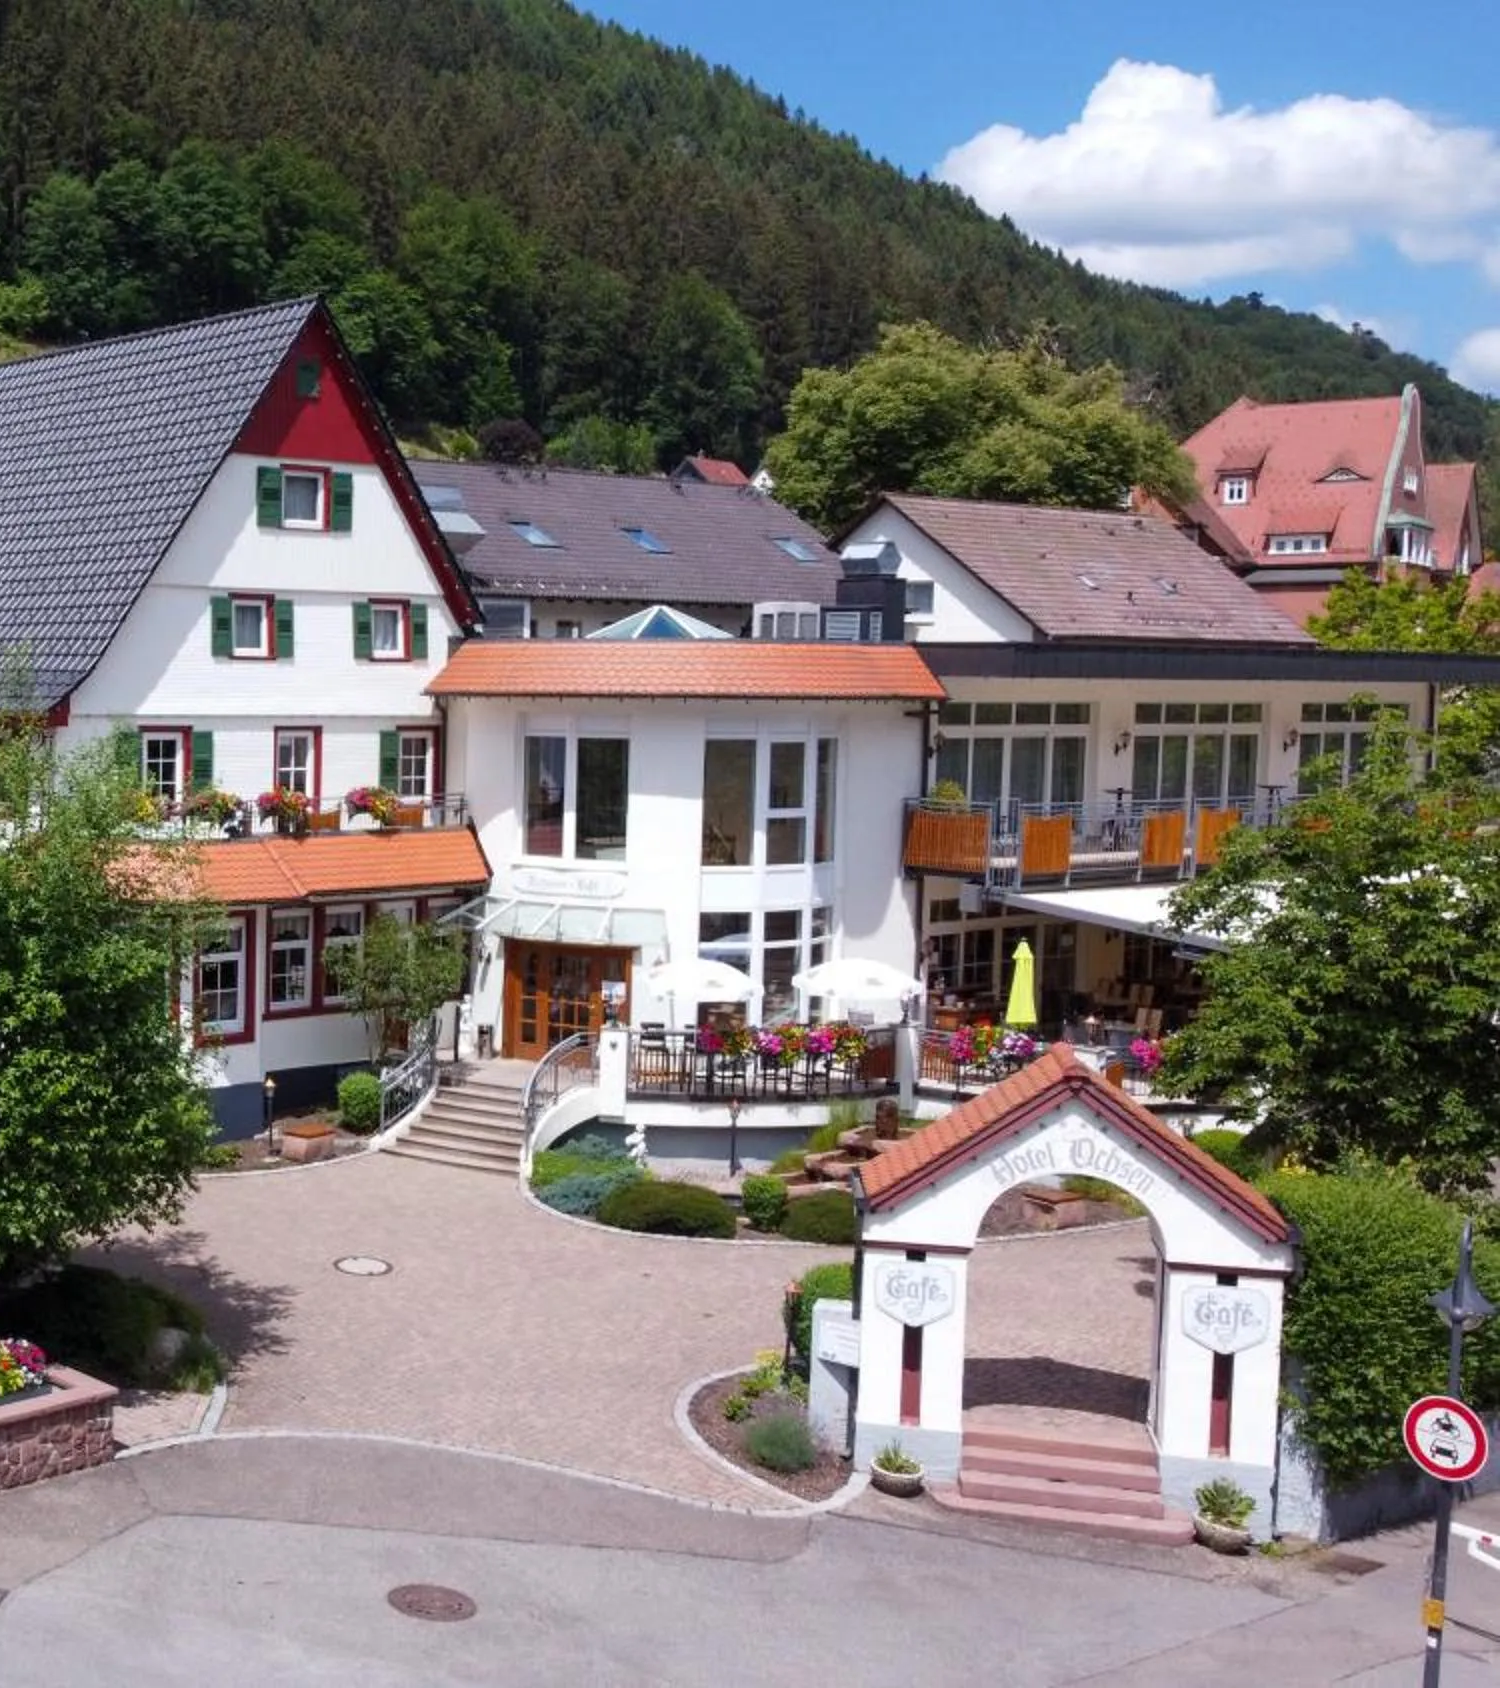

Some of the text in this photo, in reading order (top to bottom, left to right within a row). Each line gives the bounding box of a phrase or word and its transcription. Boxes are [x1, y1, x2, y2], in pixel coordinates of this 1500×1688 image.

[989, 1137, 1156, 1195] Hotel Ochsen
[885, 1269, 947, 1312] Café
[1193, 1293, 1260, 1338] Café
